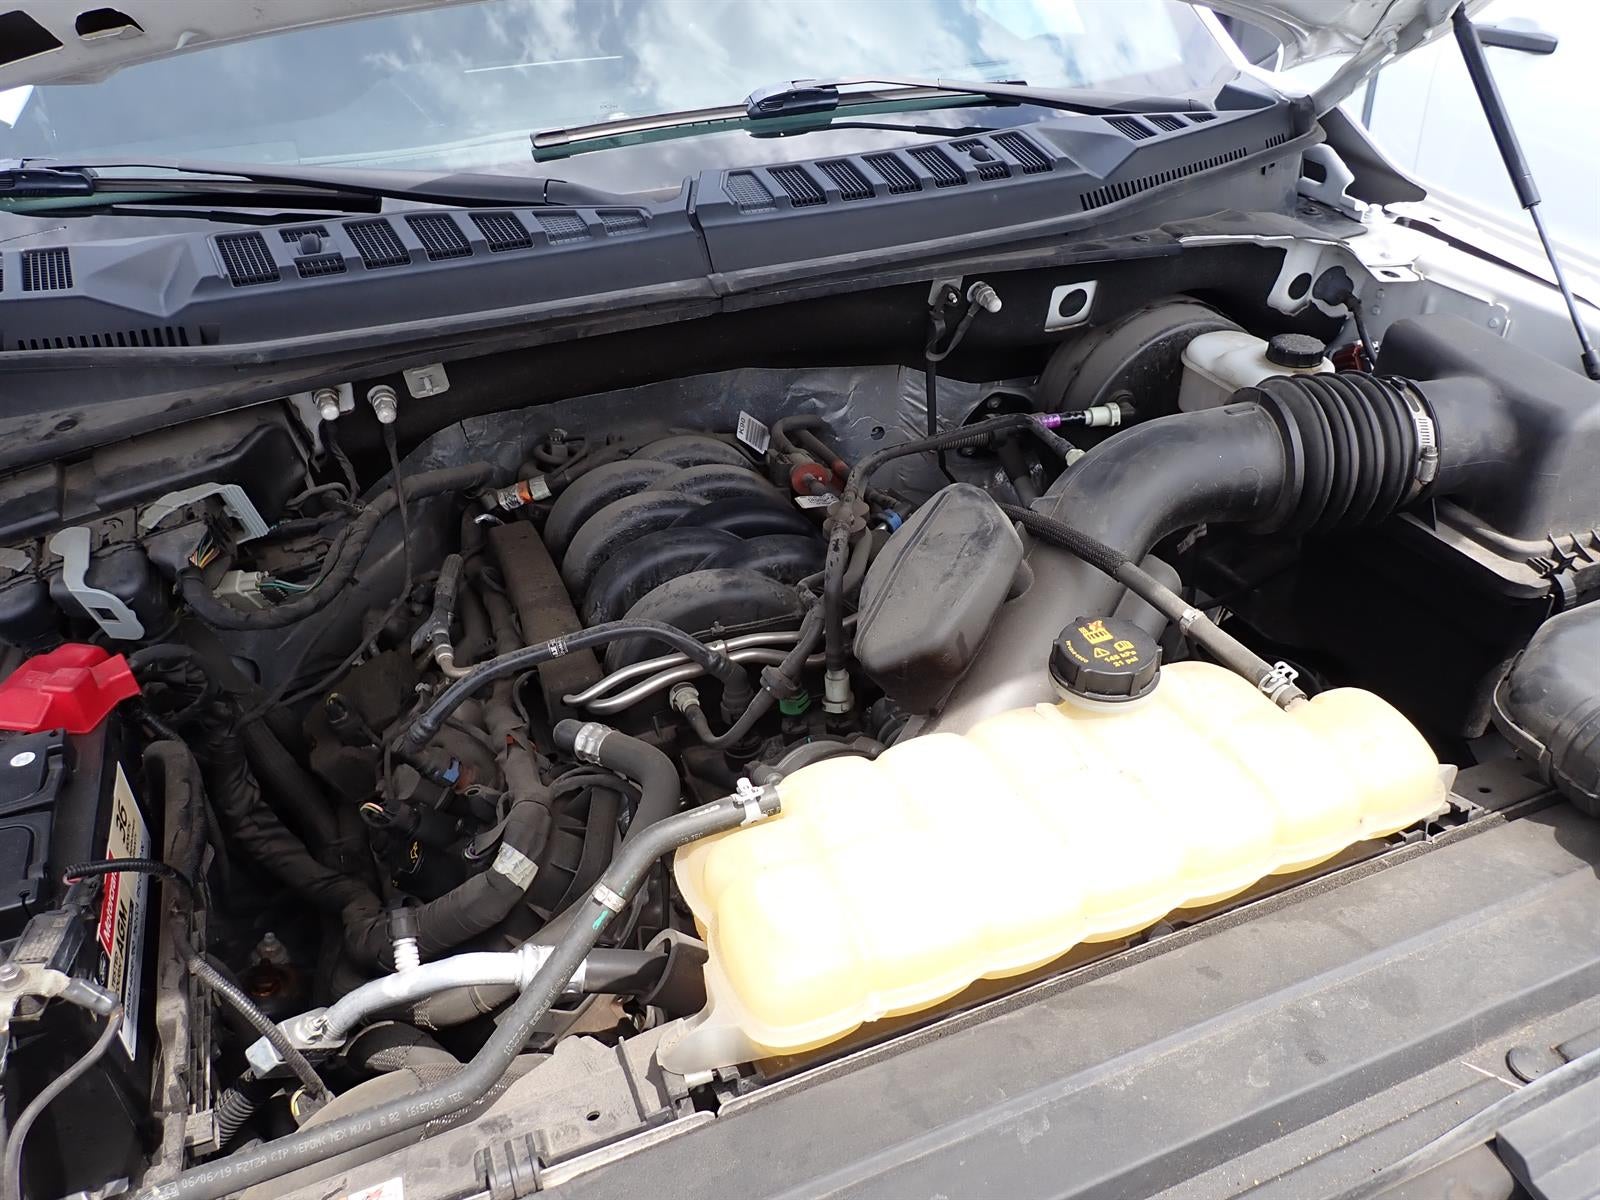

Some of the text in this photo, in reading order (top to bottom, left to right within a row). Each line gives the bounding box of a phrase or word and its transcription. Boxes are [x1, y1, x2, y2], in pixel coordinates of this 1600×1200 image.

[116, 799, 127, 843] 36
[103, 871, 118, 942] Motorcraf
[115, 899, 127, 958] AGM
